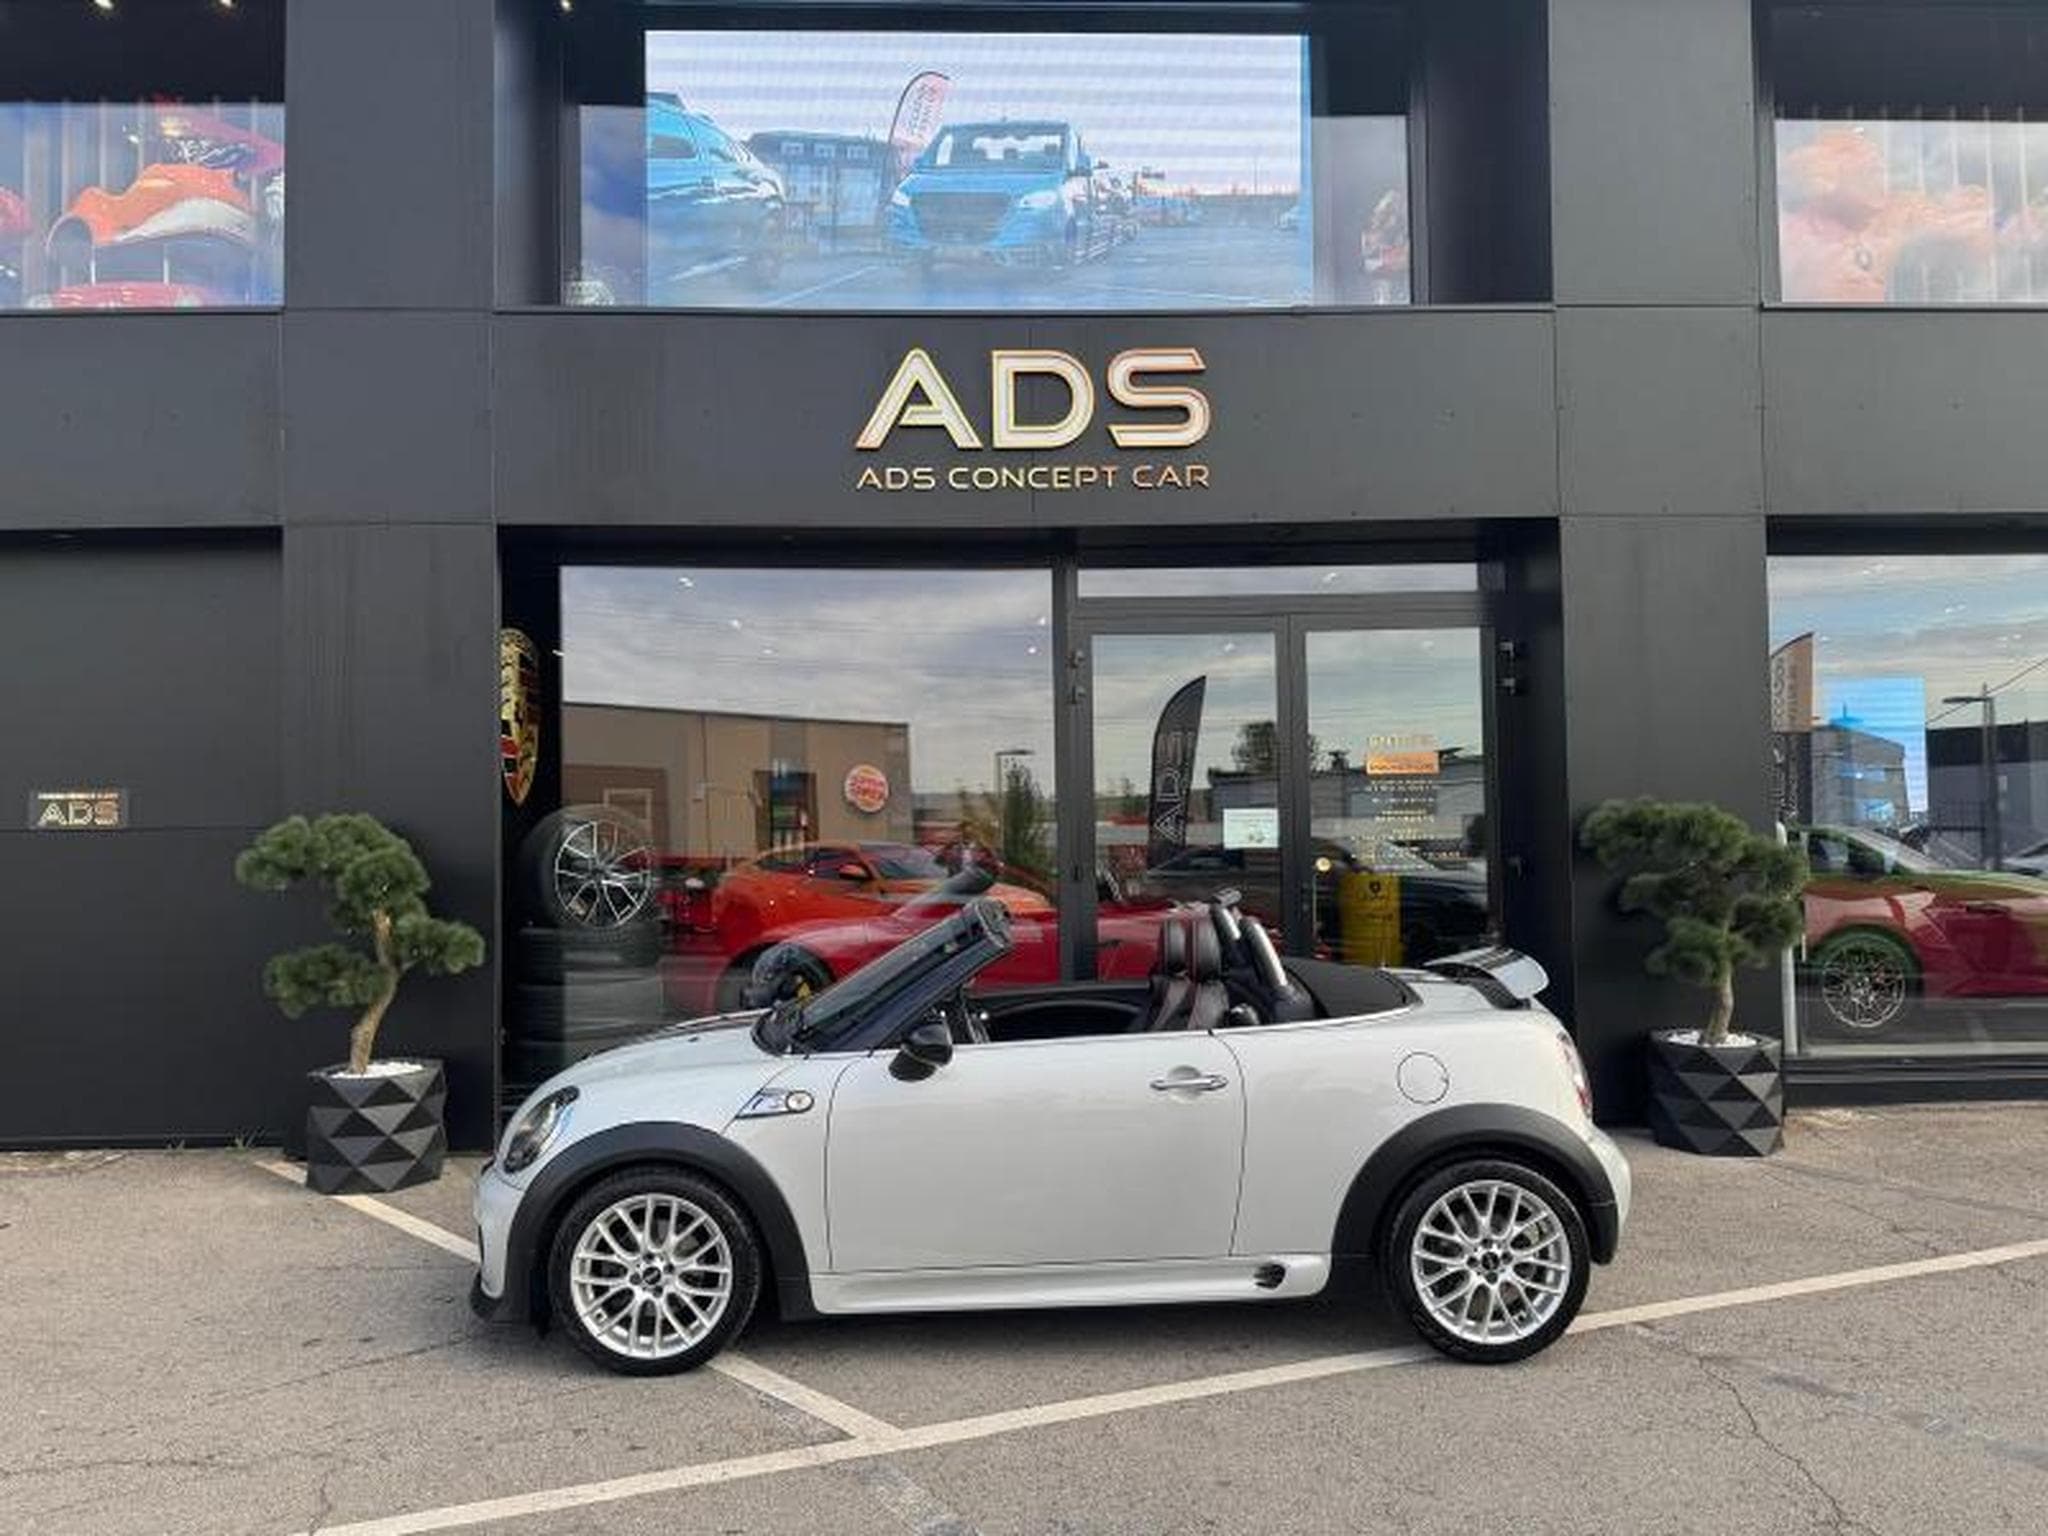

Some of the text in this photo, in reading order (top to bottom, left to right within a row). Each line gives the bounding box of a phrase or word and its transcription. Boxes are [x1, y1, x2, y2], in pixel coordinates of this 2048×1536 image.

[855, 347, 1211, 449] ADS
[856, 464, 1211, 490] ADS CONCEPT CAR
[37, 801, 119, 826] ADS
